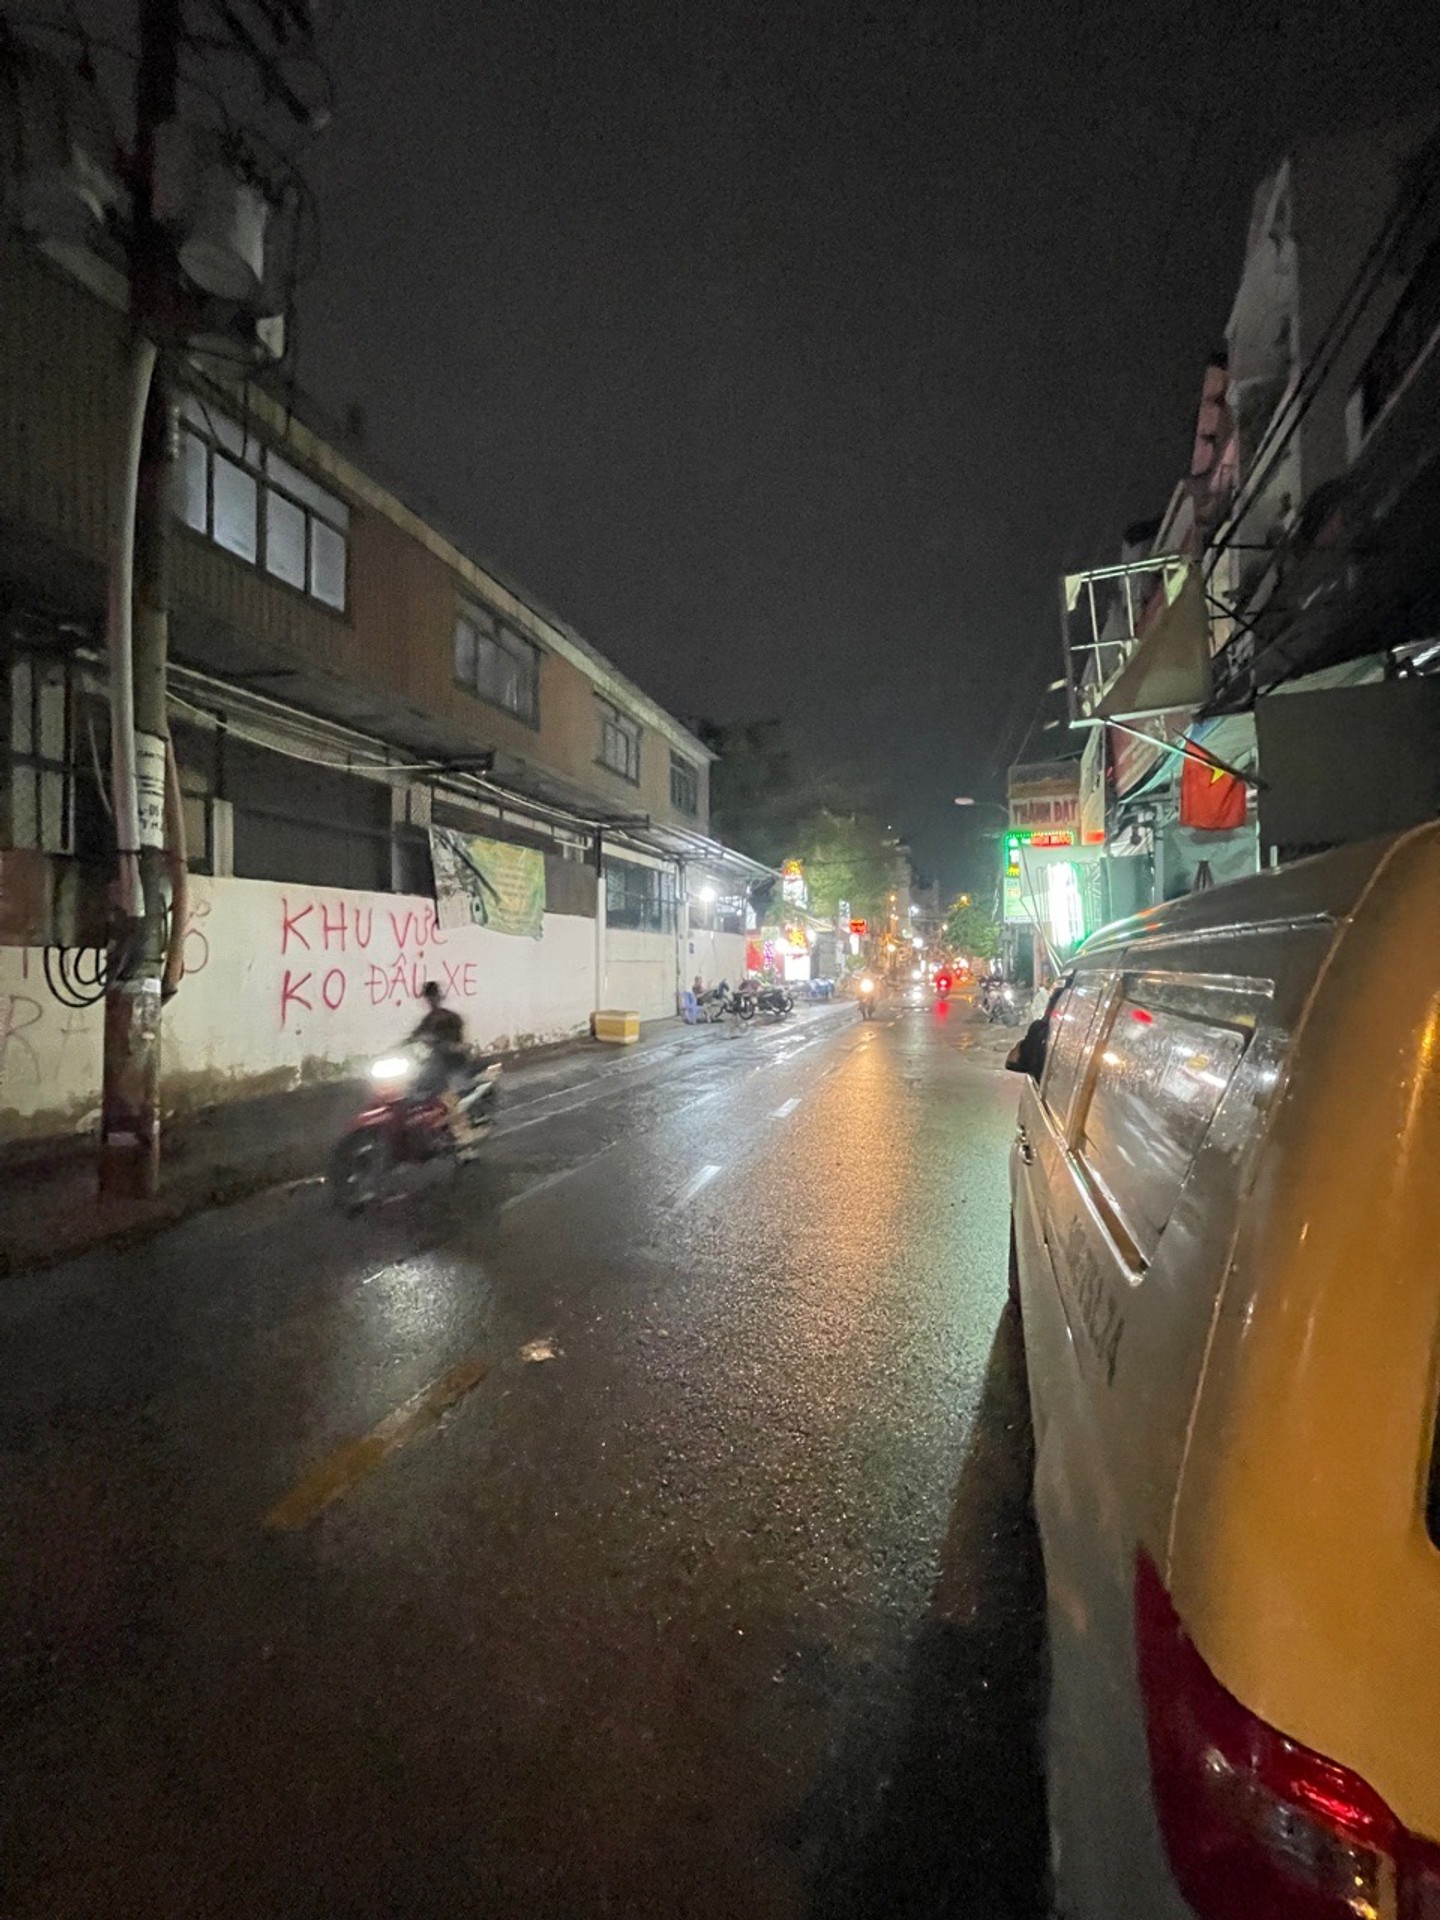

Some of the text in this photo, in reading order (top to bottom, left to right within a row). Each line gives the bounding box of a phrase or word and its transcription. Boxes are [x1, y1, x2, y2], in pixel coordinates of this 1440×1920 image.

[281, 898, 448, 958] KHU VỰC
[281, 969, 346, 1030] KO
[442, 960, 478, 998] XE
